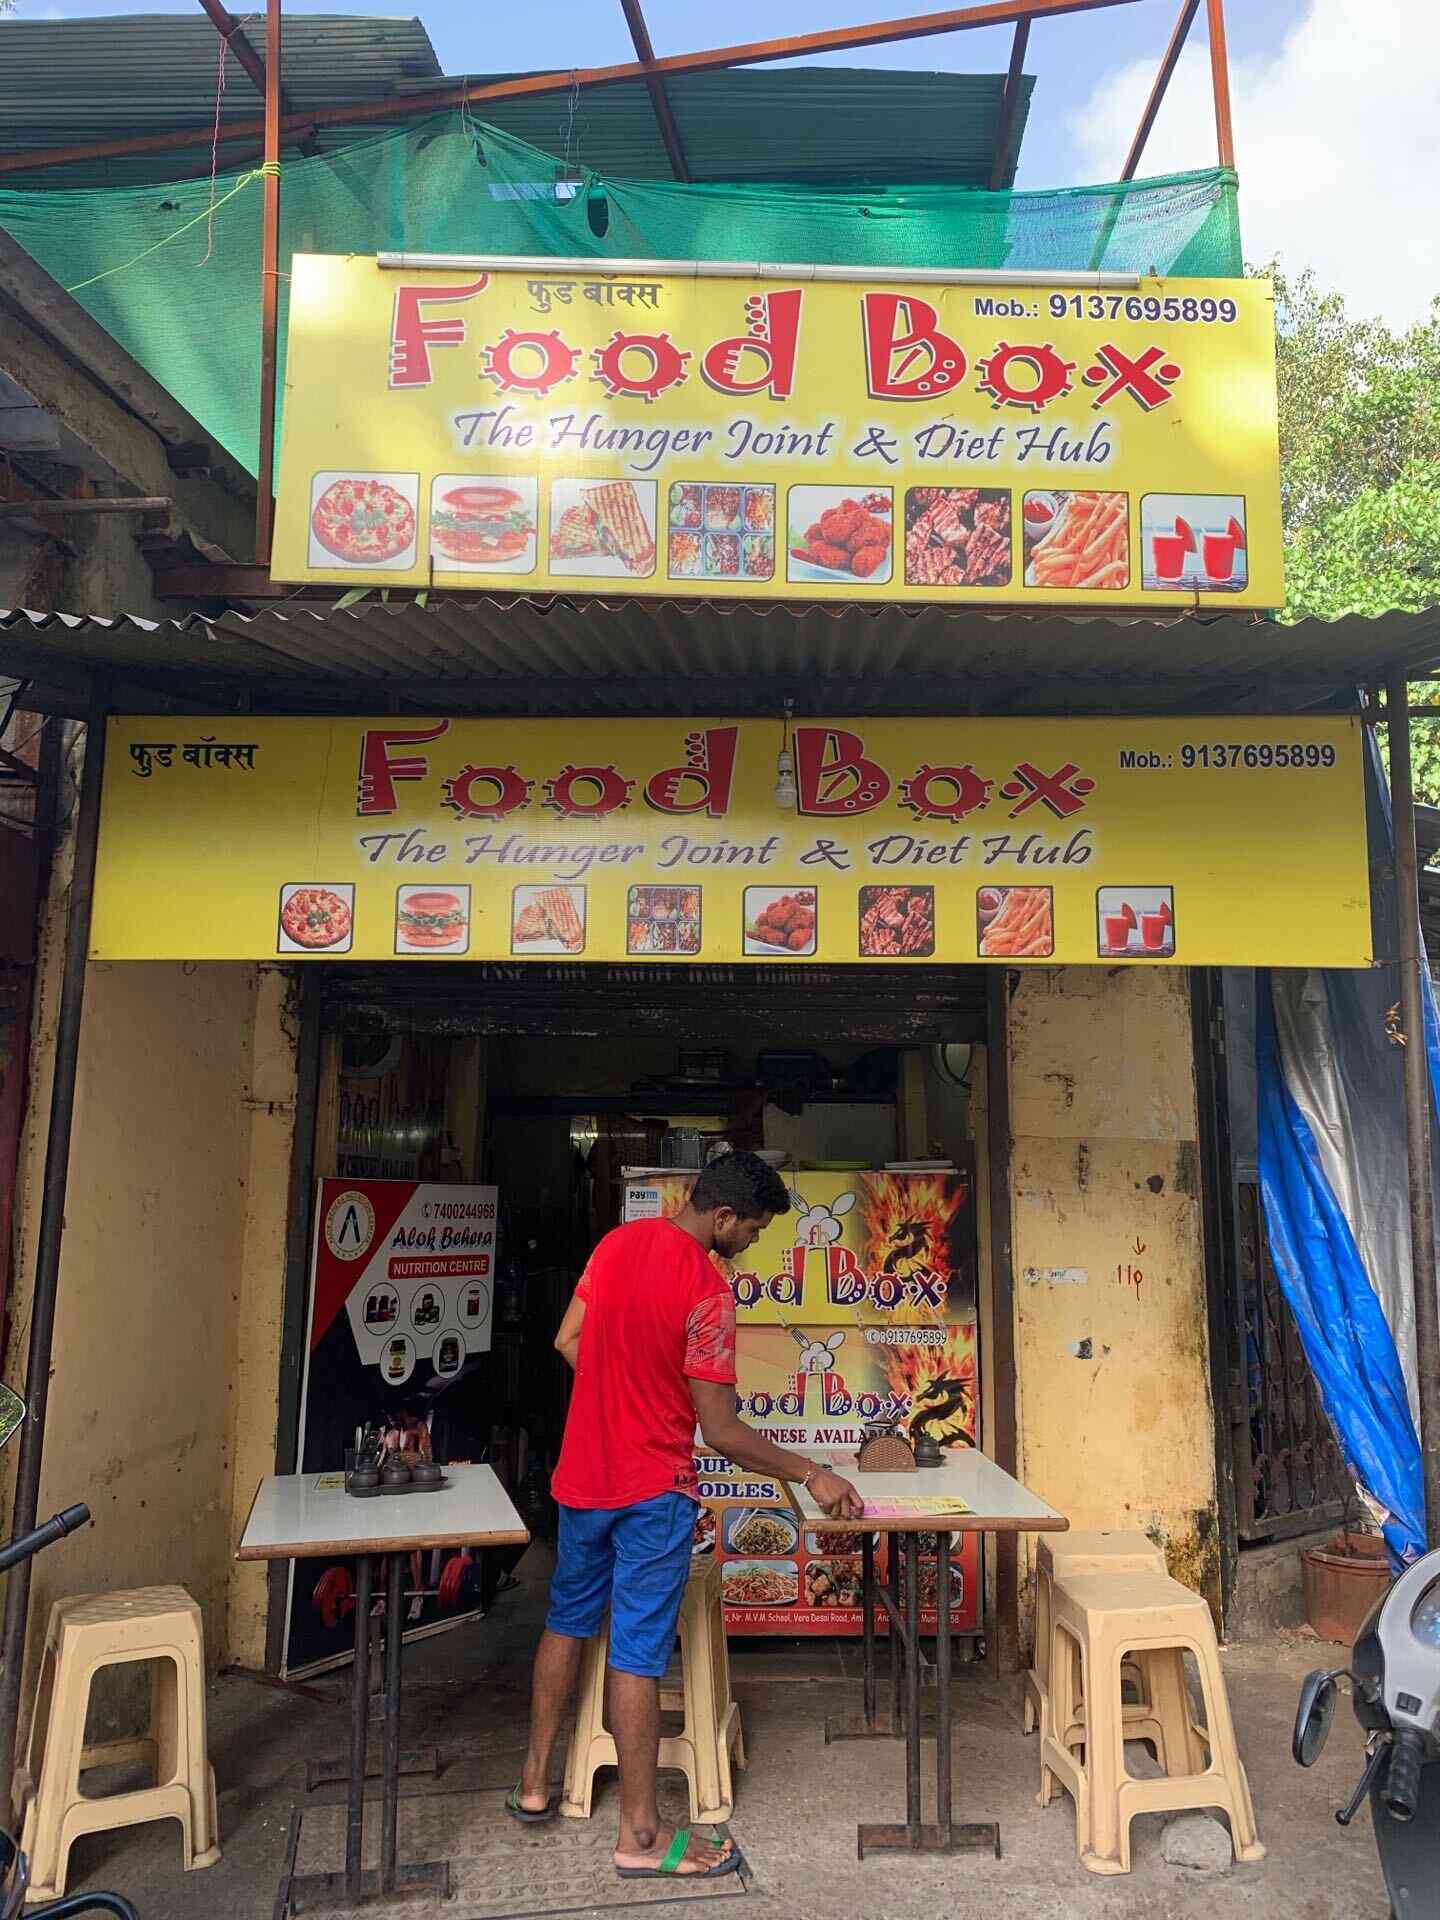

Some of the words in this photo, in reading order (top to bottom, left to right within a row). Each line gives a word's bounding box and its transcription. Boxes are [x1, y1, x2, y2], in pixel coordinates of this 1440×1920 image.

[527, 280, 577, 314] फुड
[583, 272, 663, 310] बॉक्स
[974, 298, 1040, 318] Mob.:
[1049, 294, 1237, 323] 9137695899
[388, 272, 803, 404] Food
[860, 291, 1183, 414] Box
[454, 406, 533, 448] The
[550, 413, 713, 472] Hunger
[724, 420, 833, 459] Joint
[853, 427, 899, 463] &
[914, 424, 1005, 461] Diet
[1015, 421, 1112, 463] Hub
[129, 743, 177, 777] फुड
[182, 736, 259, 771] बॉक्स
[356, 719, 739, 822] Food
[794, 727, 1096, 824] Box
[1119, 751, 1173, 769] Mob.:
[1181, 744, 1336, 769] 9137695899
[360, 828, 447, 864] The
[464, 834, 643, 880] Hunger
[658, 835, 777, 869] Joint
[799, 839, 850, 869] &
[868, 835, 971, 866] Diet
[982, 829, 1094, 866] Hub
[434, 1203, 495, 1219] 7400244968
[391, 1226, 436, 1251] Alok
[441, 1226, 492, 1249] Behera
[393, 1261, 447, 1275] NUTRITION
[449, 1259, 487, 1272] CENTRE
[729, 1245, 806, 1309] od
[827, 1246, 947, 1310] Box
[823, 1372, 912, 1419] Box
